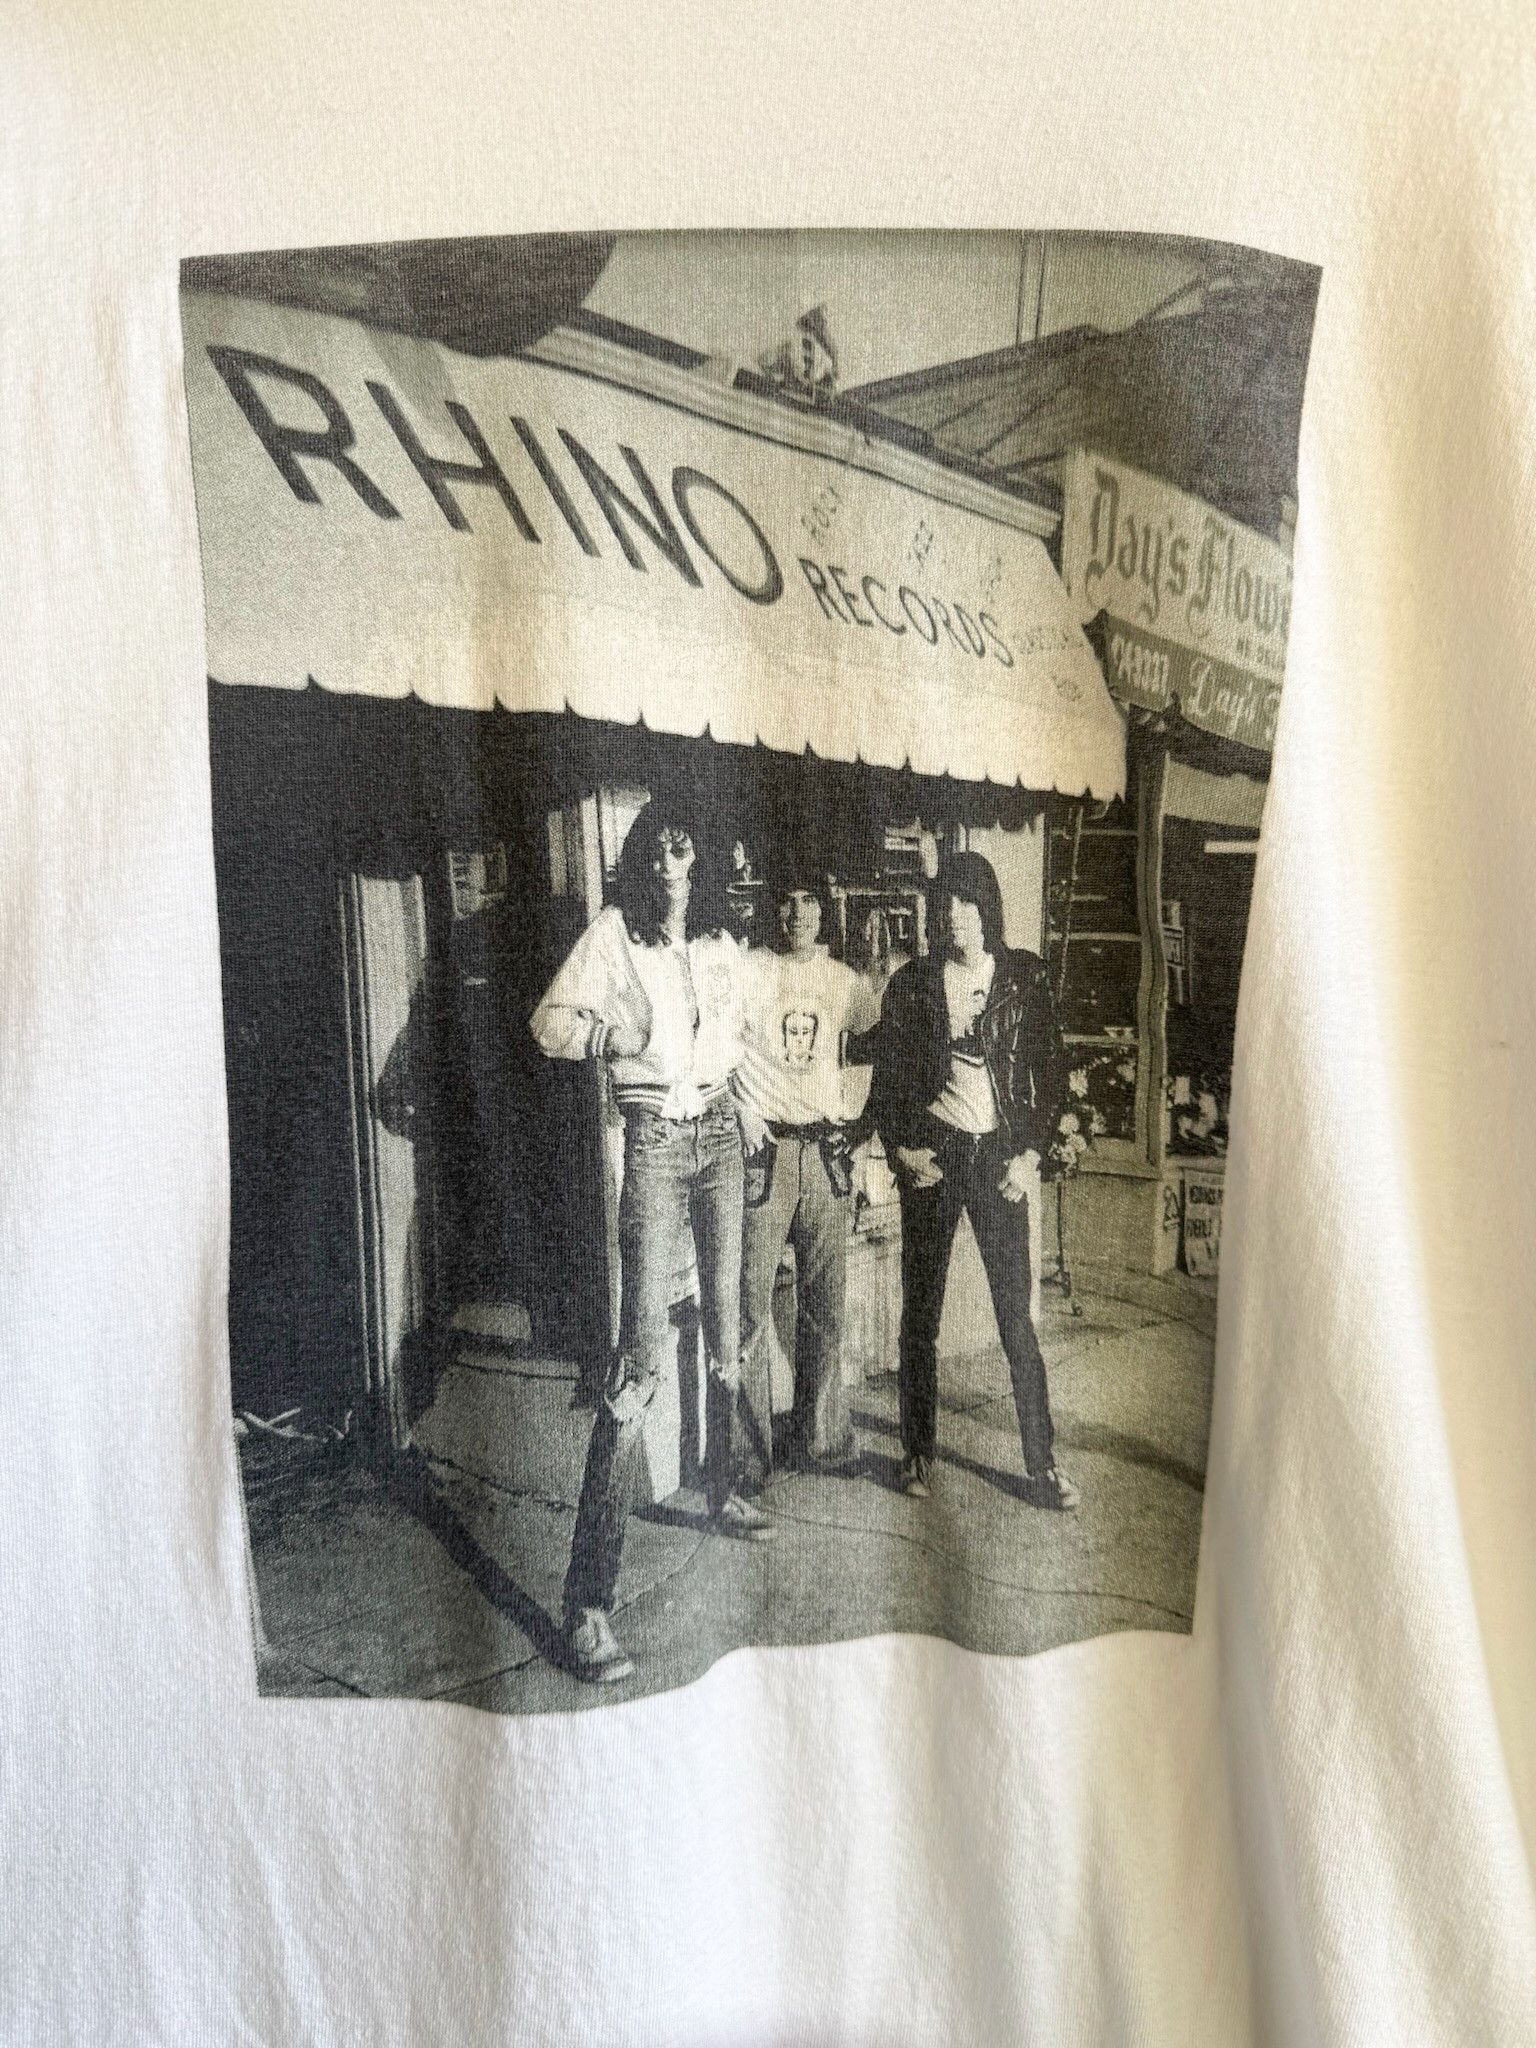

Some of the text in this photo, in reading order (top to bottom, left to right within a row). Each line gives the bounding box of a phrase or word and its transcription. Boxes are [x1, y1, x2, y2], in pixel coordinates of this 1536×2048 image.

[205, 344, 784, 606] RHINO
[1084, 466, 1189, 624] Day's
[798, 557, 1014, 668] RECORDS
